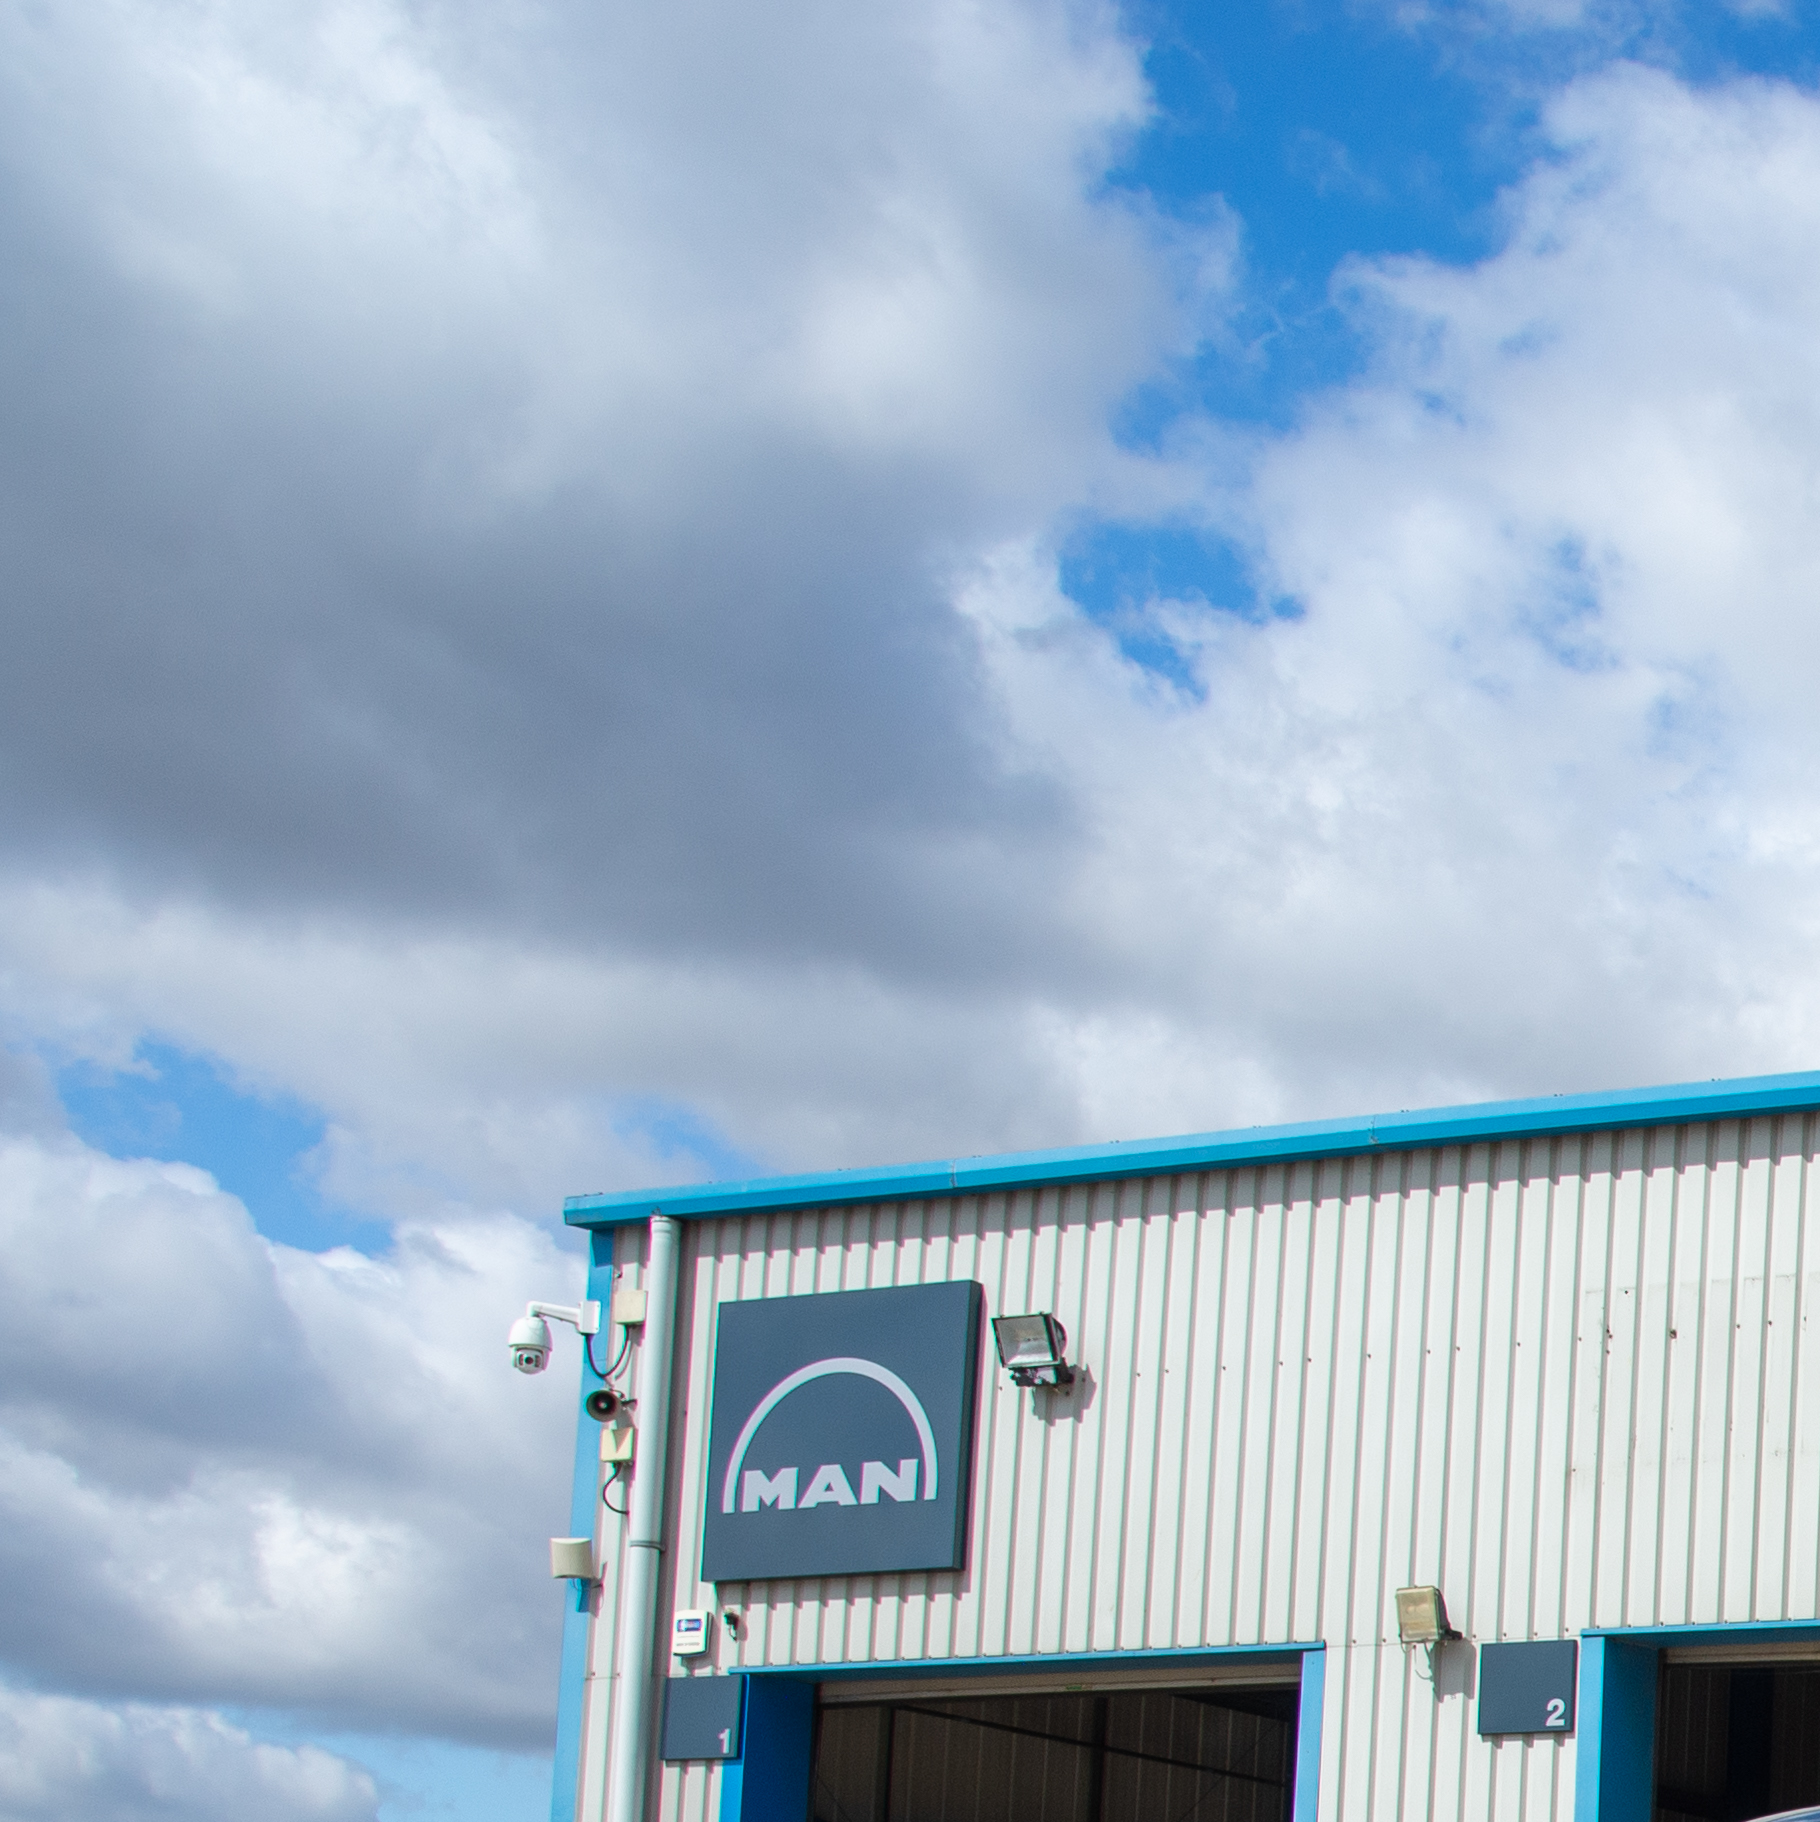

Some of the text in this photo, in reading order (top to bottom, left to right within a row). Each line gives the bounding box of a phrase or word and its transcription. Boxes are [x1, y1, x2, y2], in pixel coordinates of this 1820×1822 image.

[741, 1459, 919, 1513] MAN
[1545, 1698, 1566, 1727] 2
[718, 1728, 731, 1754] 1
